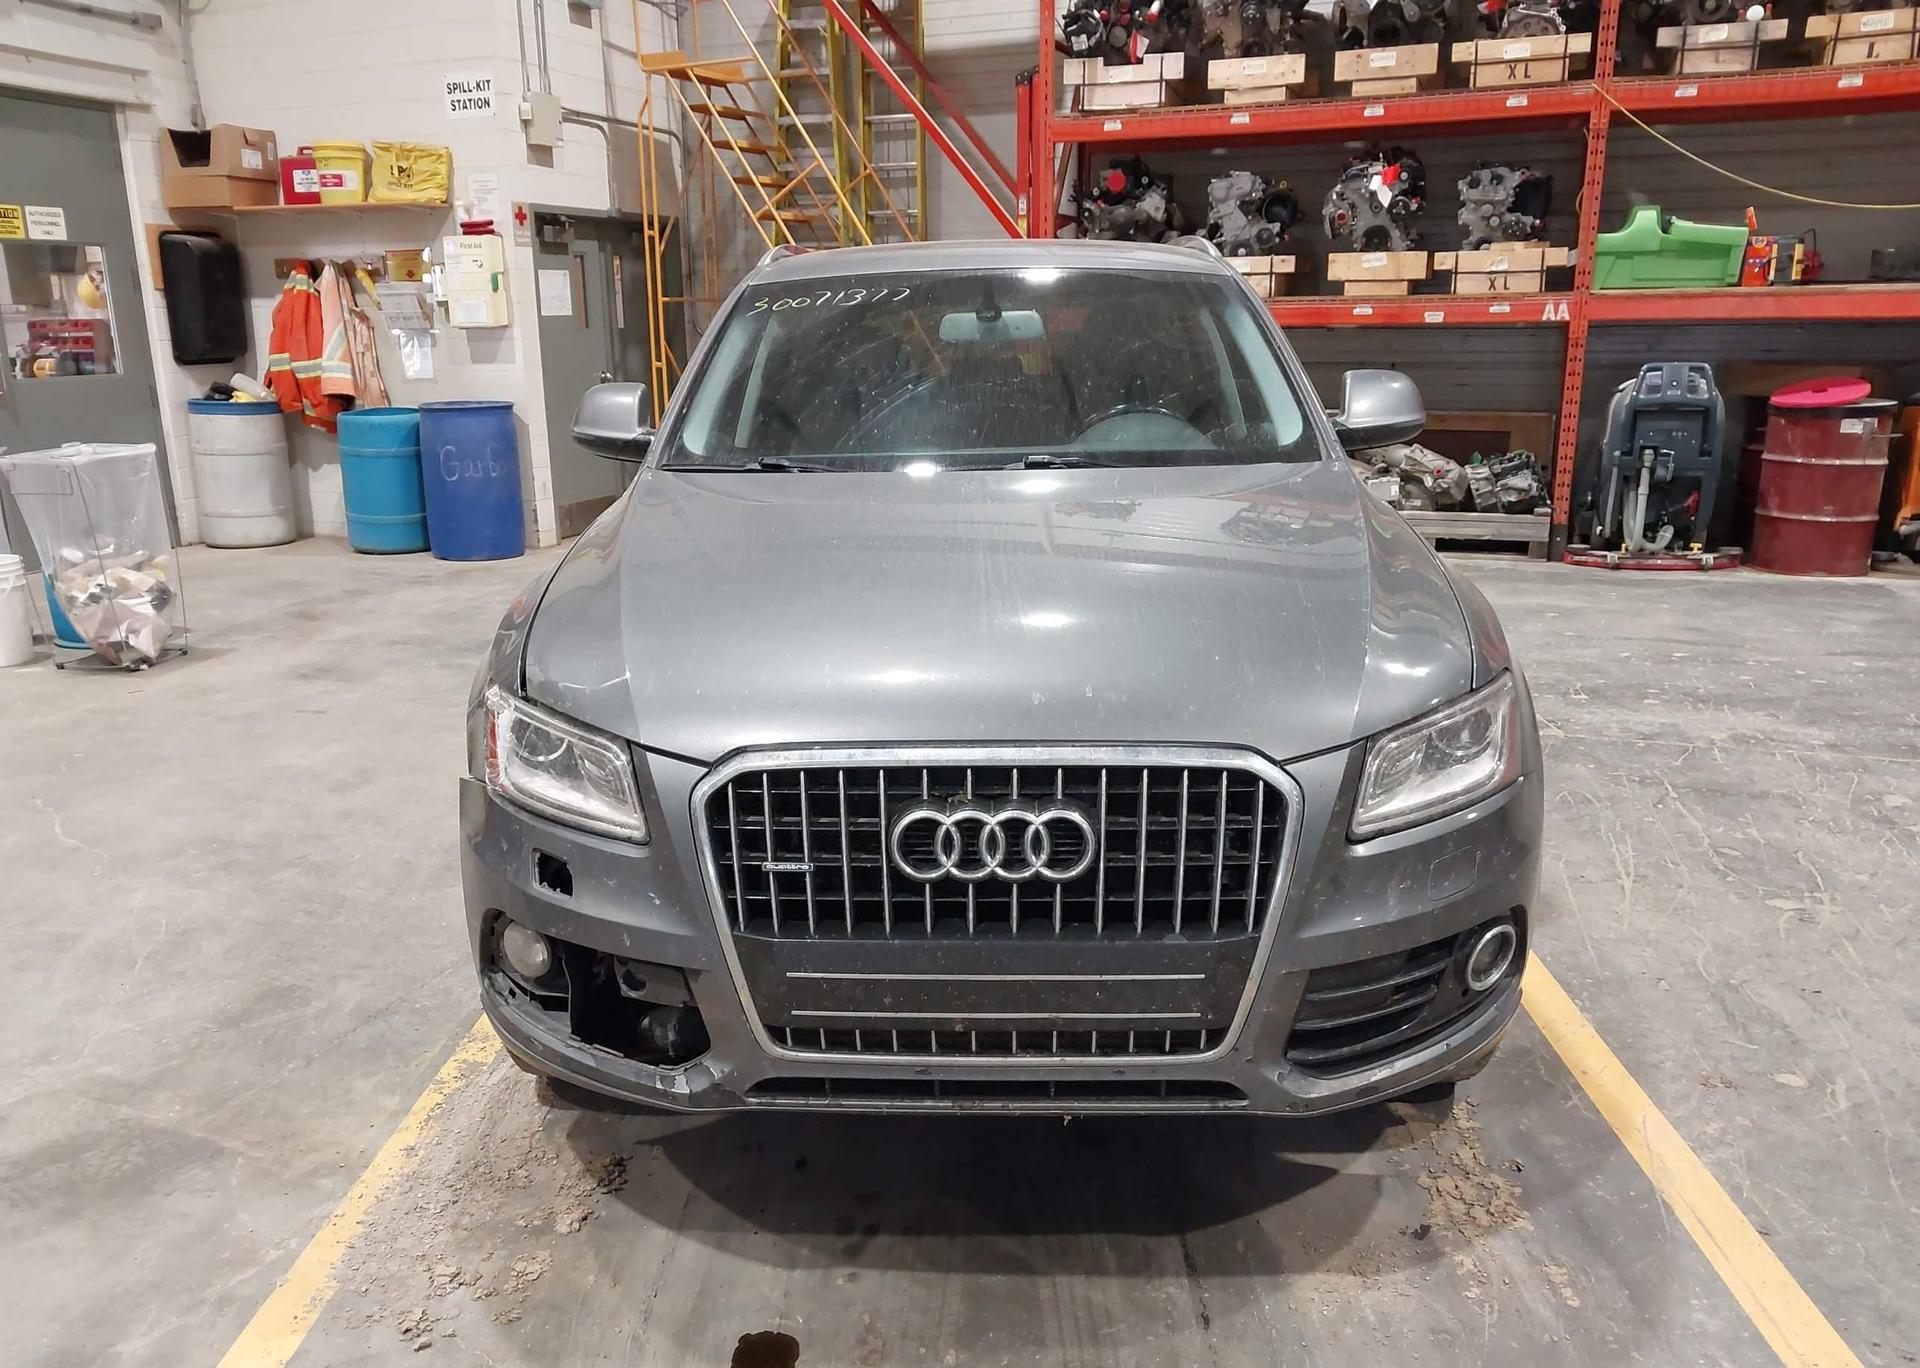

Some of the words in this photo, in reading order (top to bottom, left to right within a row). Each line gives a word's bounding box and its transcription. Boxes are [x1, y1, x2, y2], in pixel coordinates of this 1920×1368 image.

[446, 79, 491, 95] SPILL-KIT
[450, 96, 491, 111] STATION
[0, 208, 19, 218] TION
[1542, 300, 1570, 321] AA
